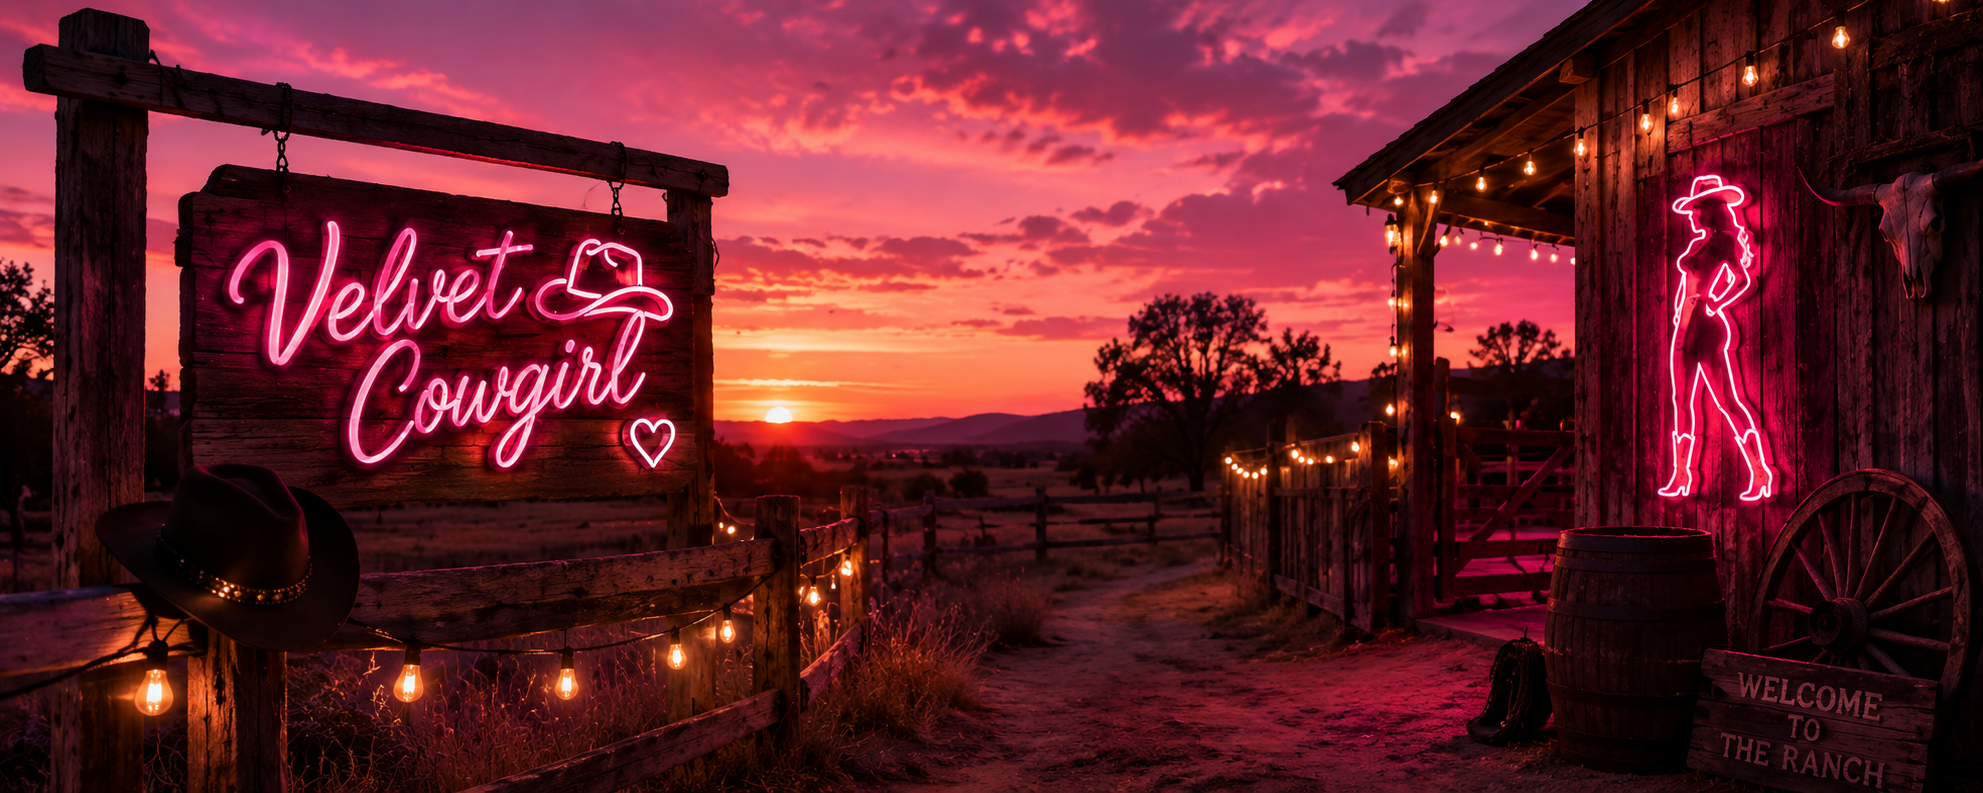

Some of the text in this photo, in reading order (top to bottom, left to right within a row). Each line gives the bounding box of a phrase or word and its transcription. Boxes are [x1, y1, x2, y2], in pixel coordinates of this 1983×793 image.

[228, 220, 534, 367] Velvet
[346, 309, 646, 469] Cowgirl
[1737, 672, 1883, 721] WELCOME
[1787, 713, 1821, 742] TO
[1720, 732, 1885, 789] THE RANCH
